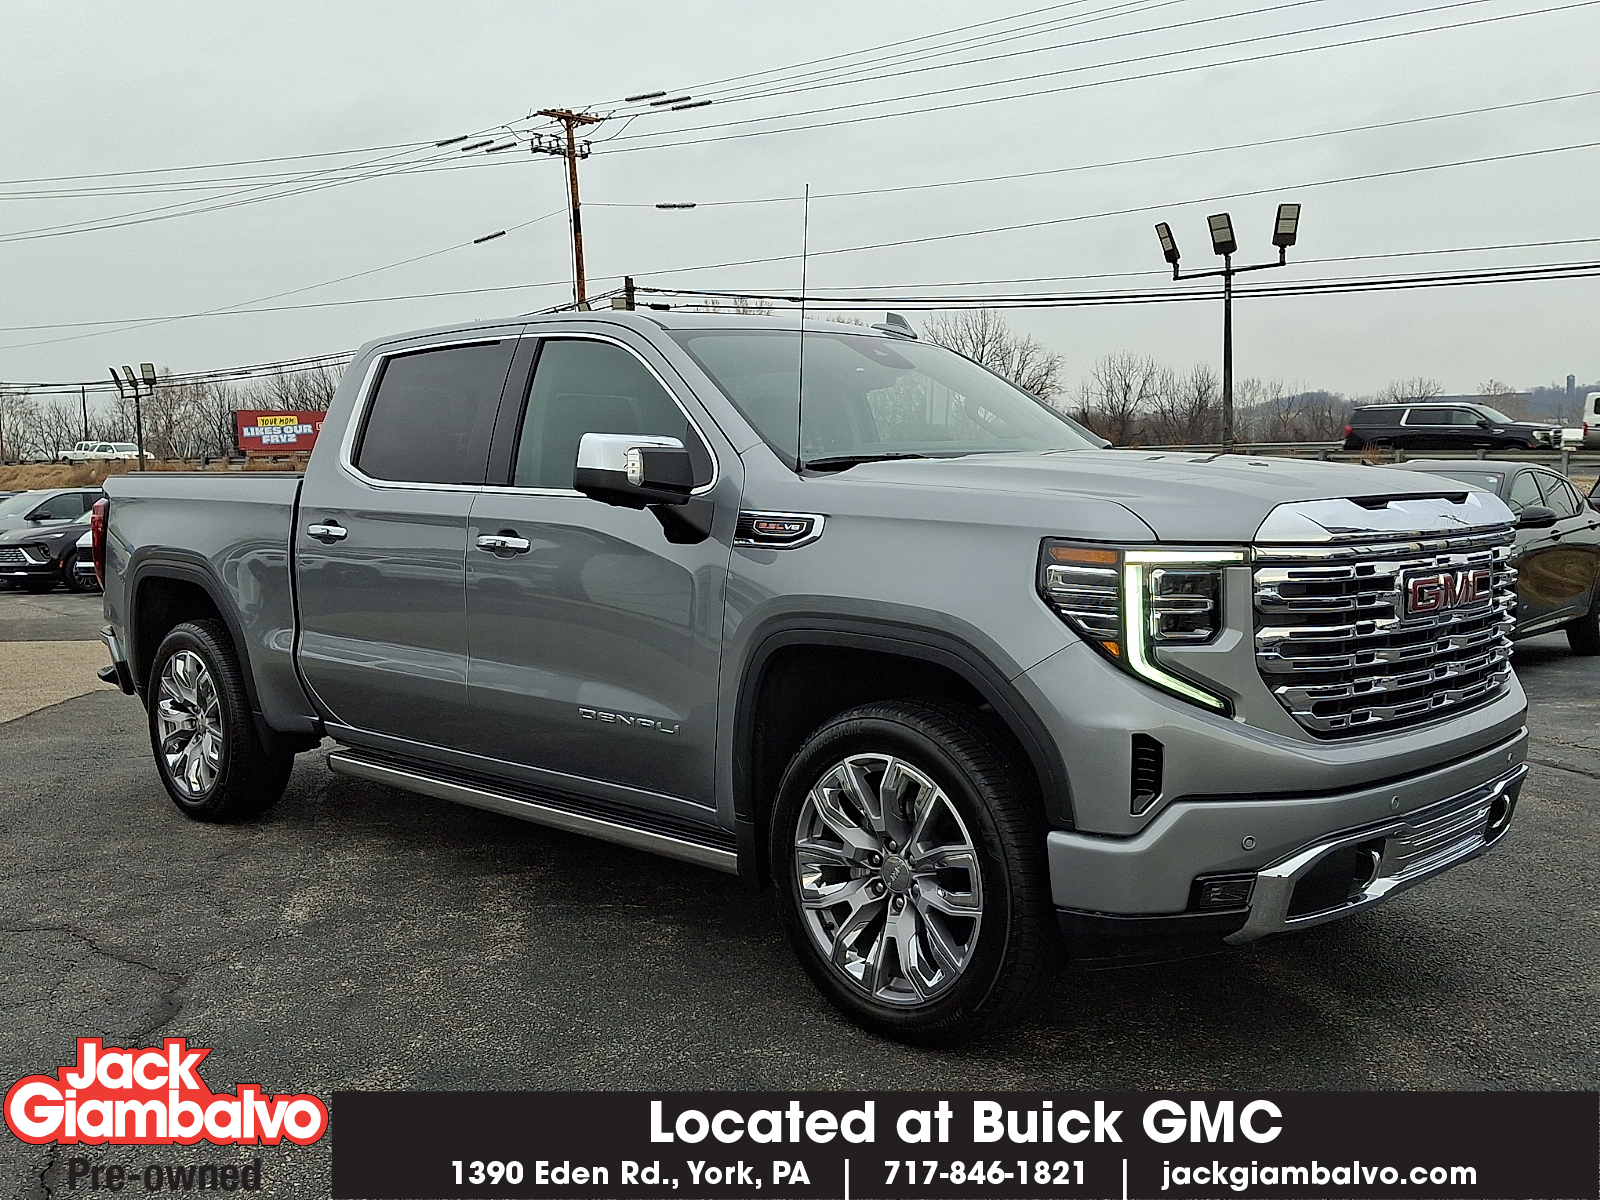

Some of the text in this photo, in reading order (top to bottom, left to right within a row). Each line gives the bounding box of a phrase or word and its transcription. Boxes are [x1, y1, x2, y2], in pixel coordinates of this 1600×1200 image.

[243, 426, 282, 436] LIKES
[283, 424, 313, 434] OUR
[260, 417, 295, 426] YOUR MOM
[1407, 570, 1491, 614] GMC
[578, 707, 681, 735] DENALI
